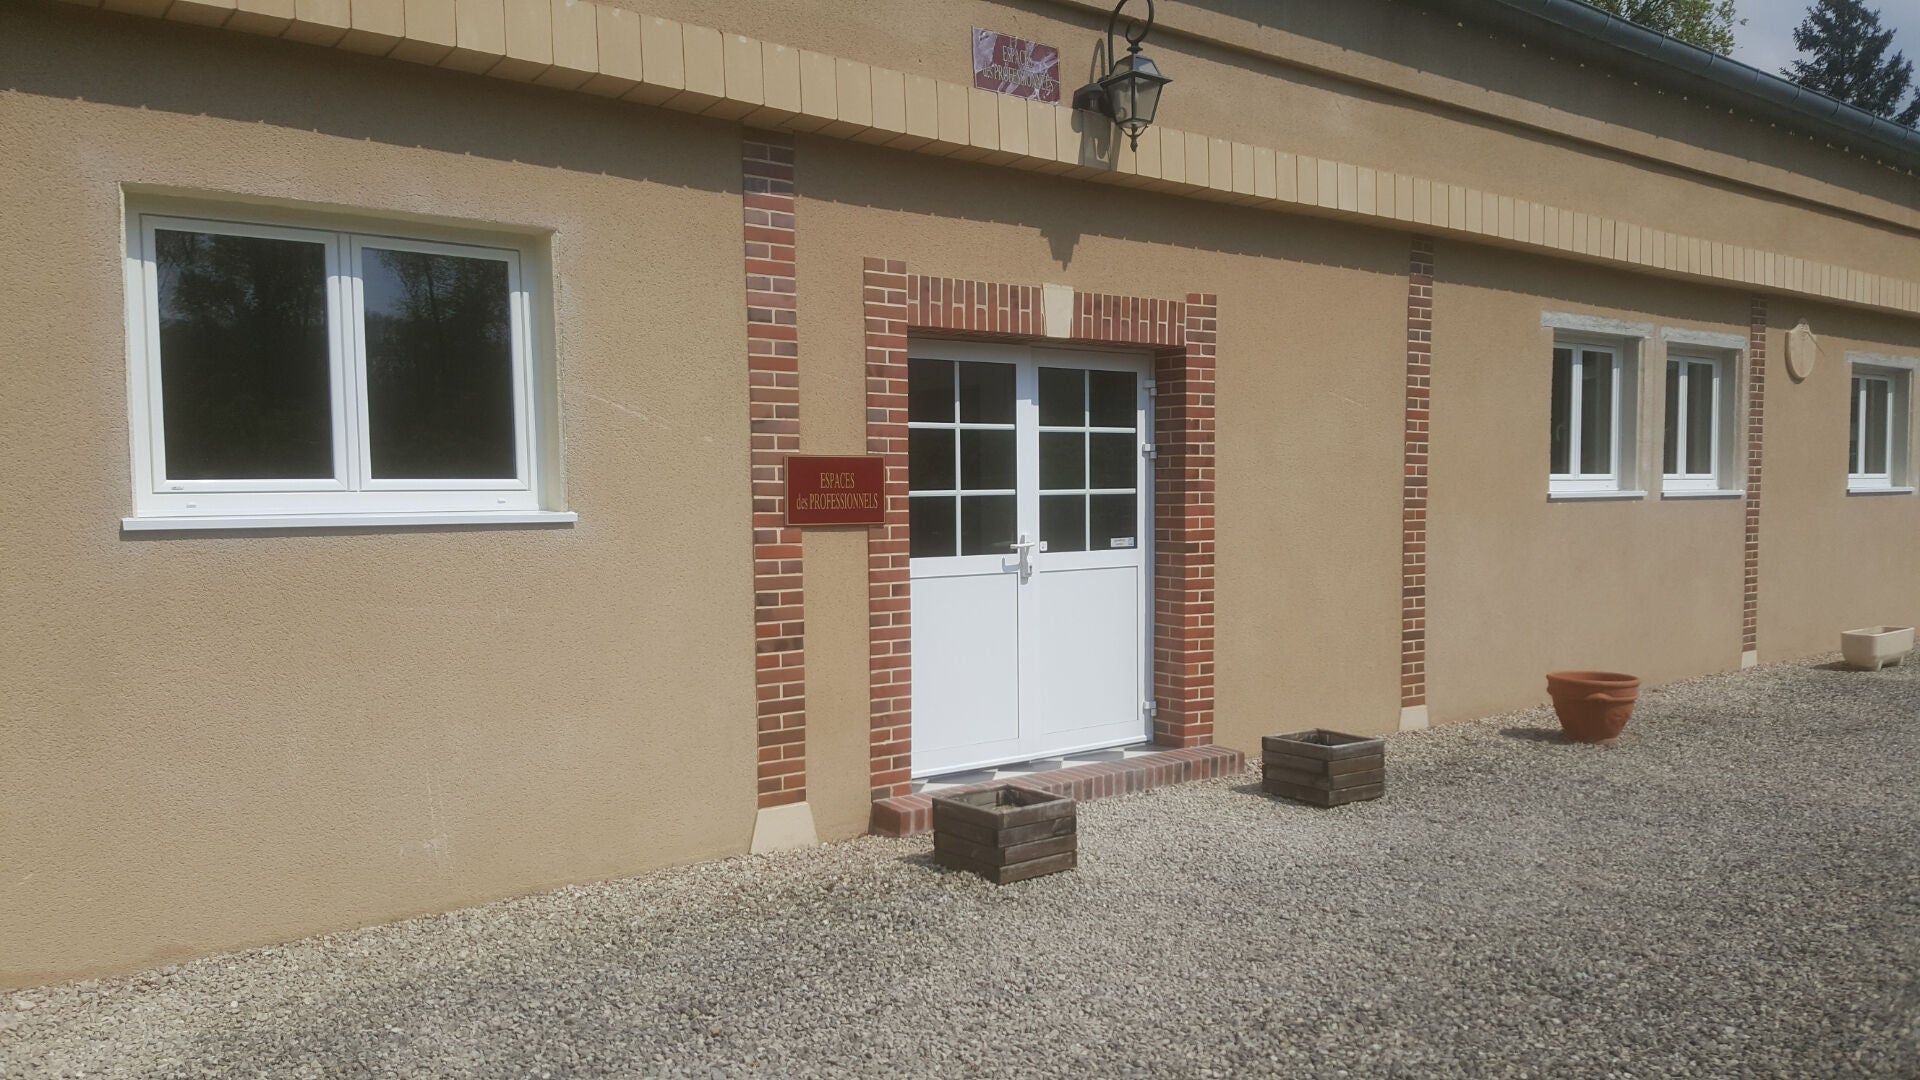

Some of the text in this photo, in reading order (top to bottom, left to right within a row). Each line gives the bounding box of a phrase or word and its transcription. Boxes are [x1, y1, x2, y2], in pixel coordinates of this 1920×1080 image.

[820, 472, 855, 489] ESPACES
[797, 492, 878, 510] des PROFESSIONNELS
